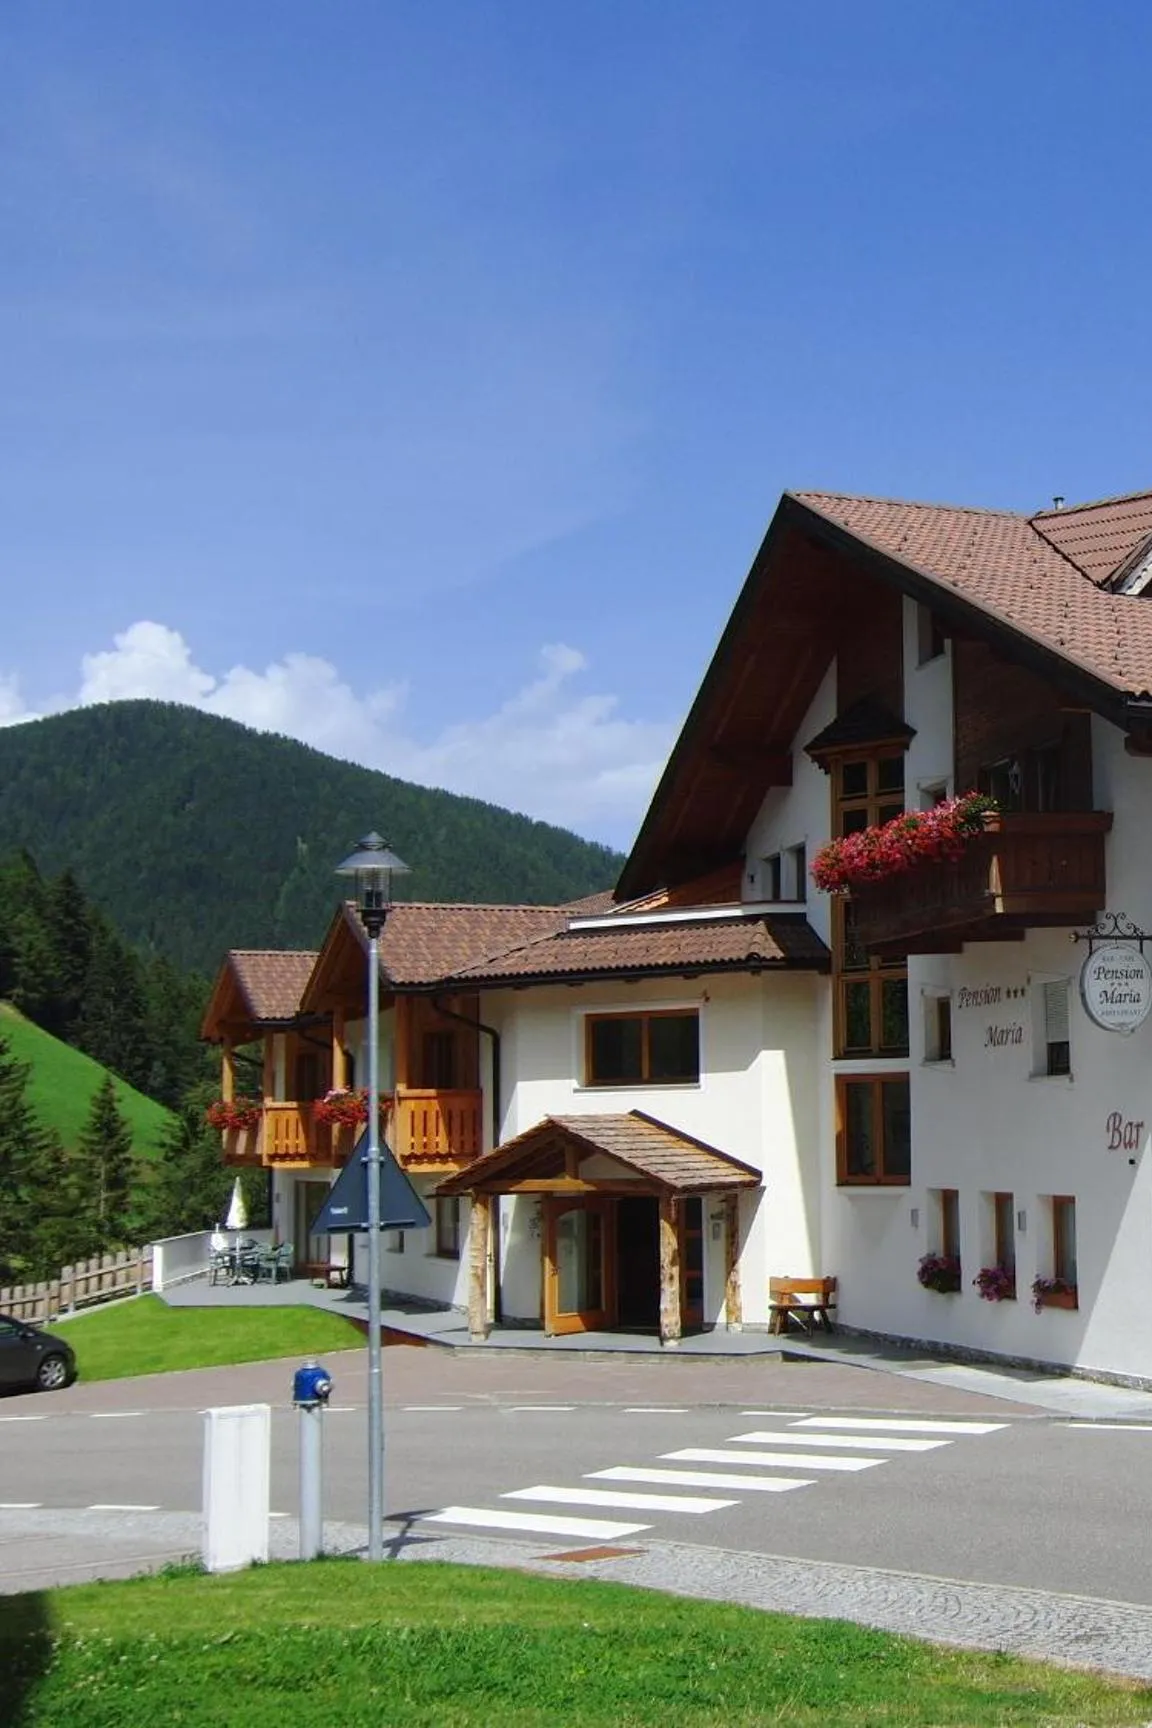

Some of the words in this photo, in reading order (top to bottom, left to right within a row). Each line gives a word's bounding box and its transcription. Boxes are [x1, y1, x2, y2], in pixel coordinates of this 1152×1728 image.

[1094, 965, 1144, 981] Pension
[958, 986, 1001, 1008] Pension
[1100, 988, 1142, 1004] Maria
[984, 1022, 1023, 1047] Maria
[1106, 1111, 1144, 1150] Bar
